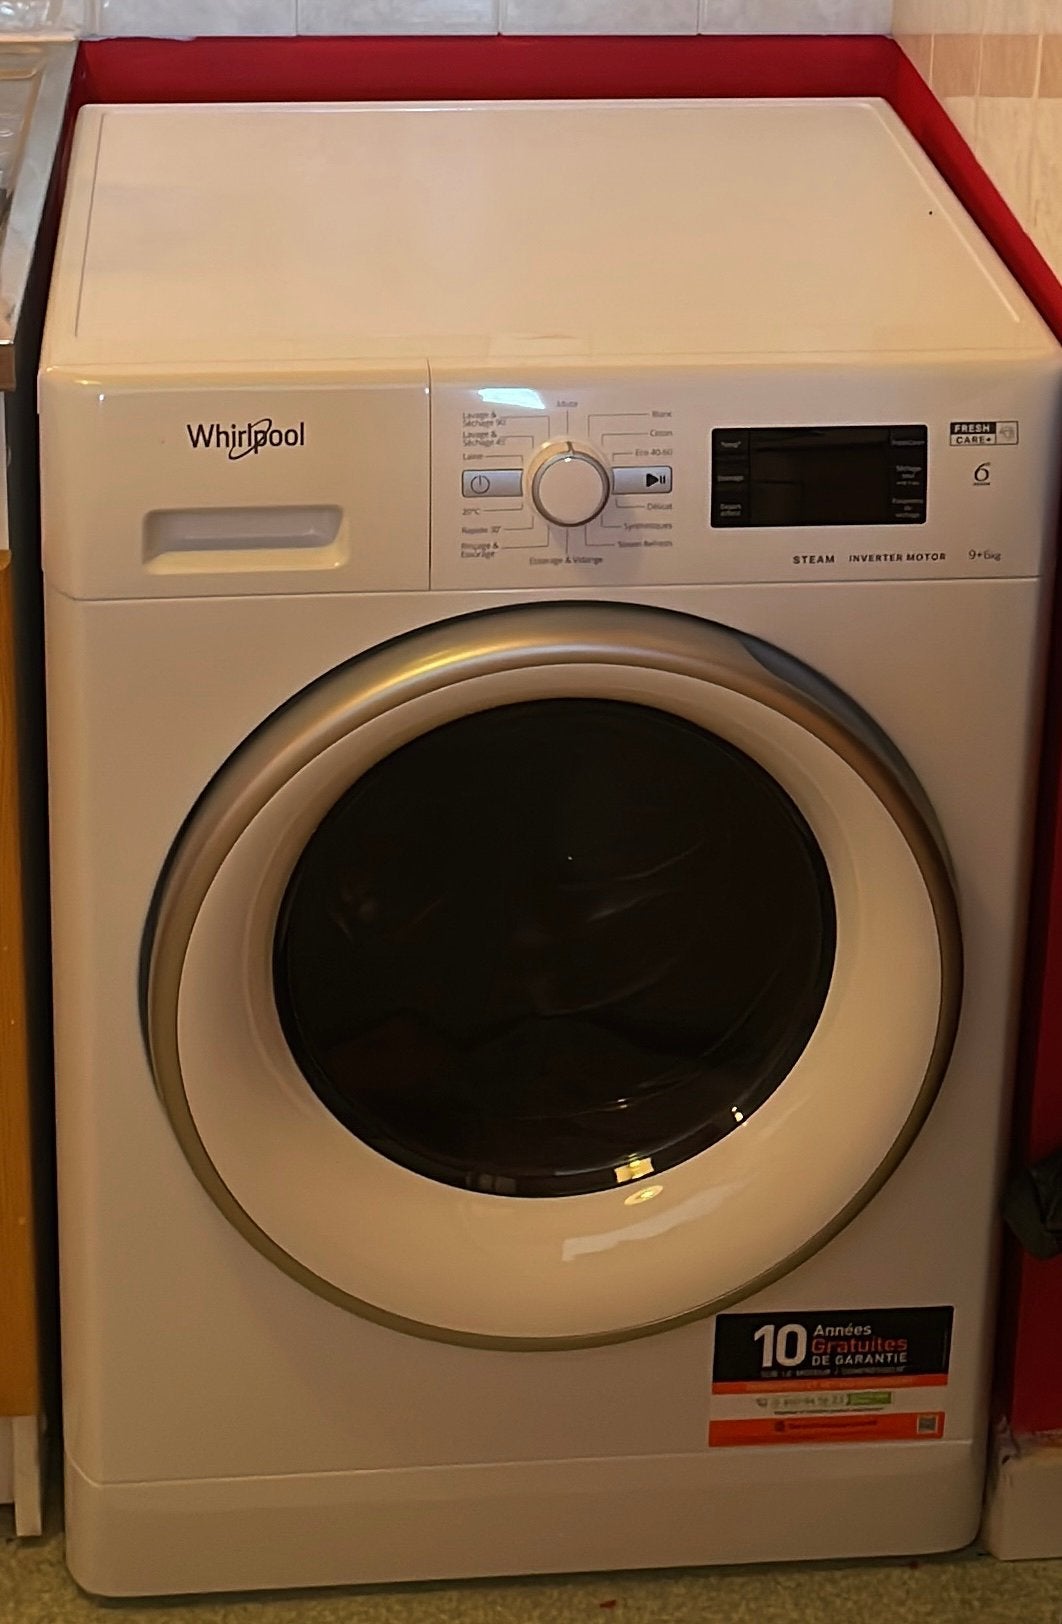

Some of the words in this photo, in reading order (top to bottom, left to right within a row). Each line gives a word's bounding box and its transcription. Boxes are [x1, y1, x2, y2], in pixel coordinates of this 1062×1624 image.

[954, 424, 990, 433] FRESH
[187, 418, 305, 460] Whirlpool
[956, 434, 992, 445] CARE+
[792, 555, 835, 564] STEAM
[848, 552, 903, 562] INVERTER
[906, 552, 947, 562] MOTOR
[813, 1323, 872, 1338] Années
[754, 1323, 808, 1368] 10
[812, 1337, 908, 1355] Gratuites
[812, 1355, 830, 1366] DE
[834, 1351, 908, 1365] GARANTIE
